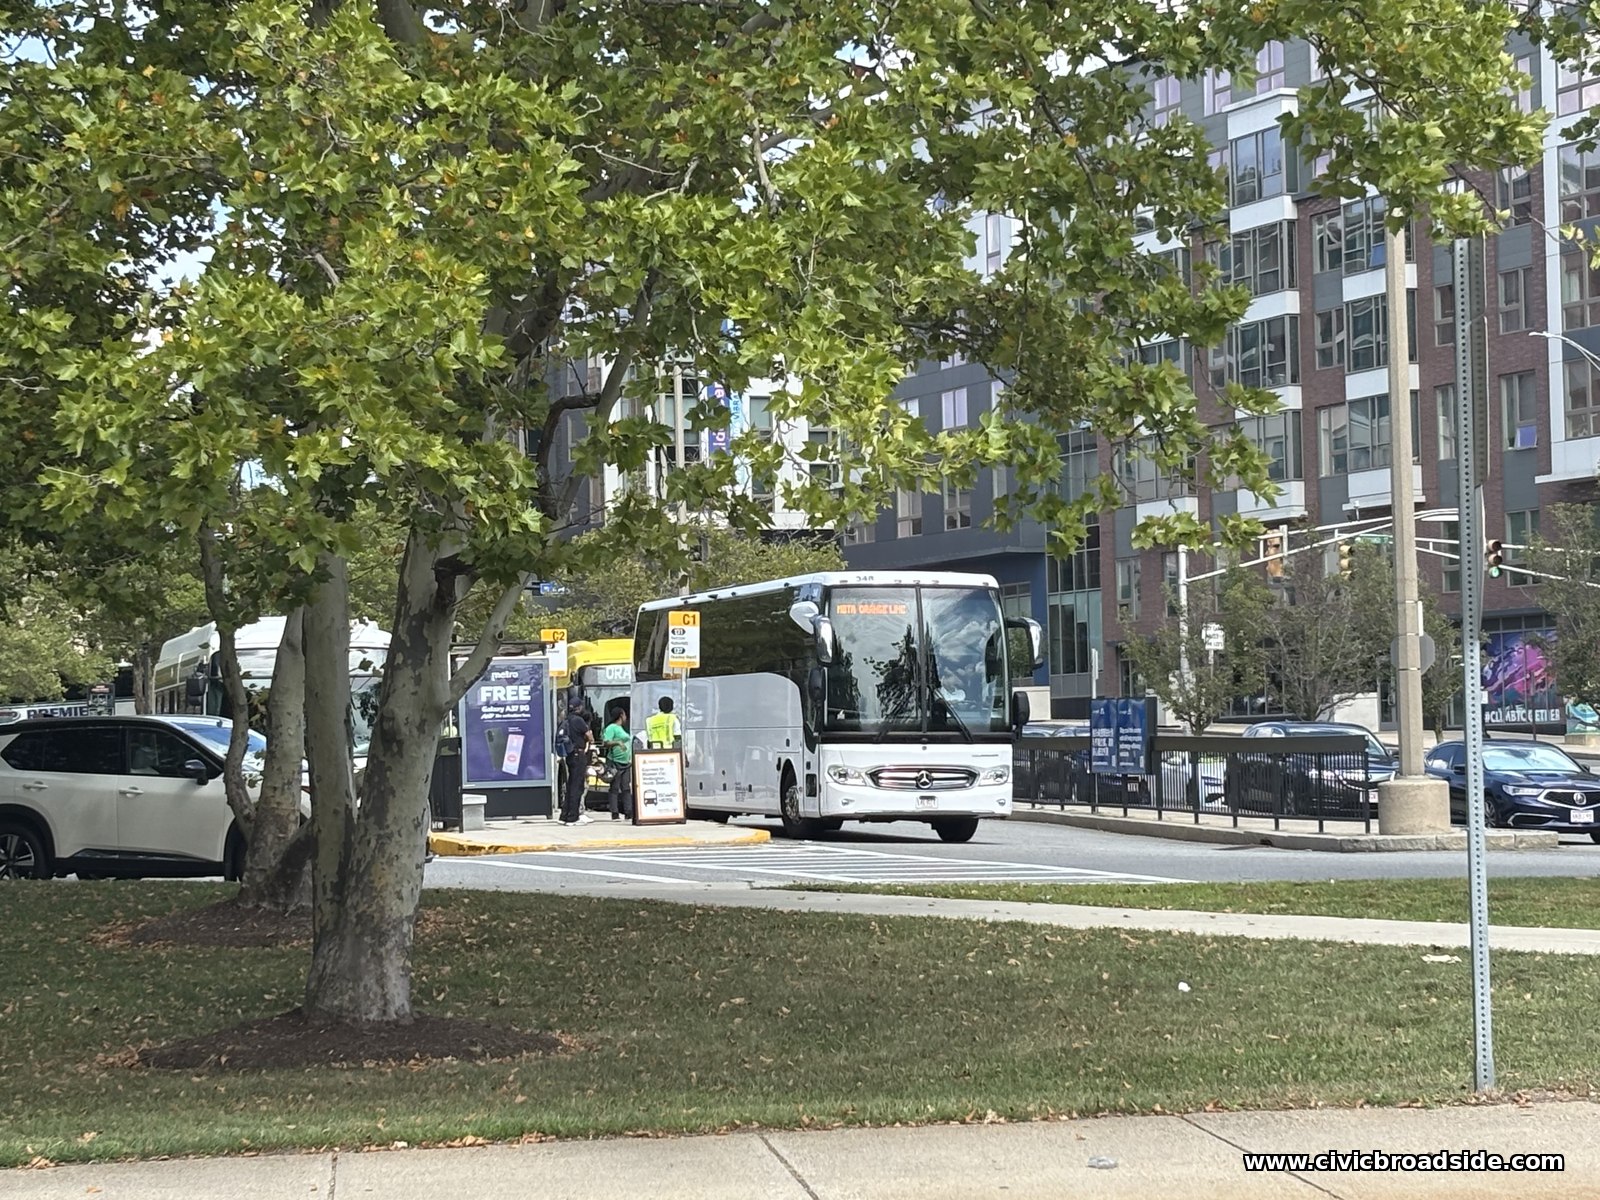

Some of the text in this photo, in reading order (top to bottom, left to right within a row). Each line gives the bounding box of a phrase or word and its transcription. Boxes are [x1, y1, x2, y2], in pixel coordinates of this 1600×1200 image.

[682, 613, 697, 626] C1
[552, 630, 565, 642] C2
[480, 685, 531, 702] FREE
